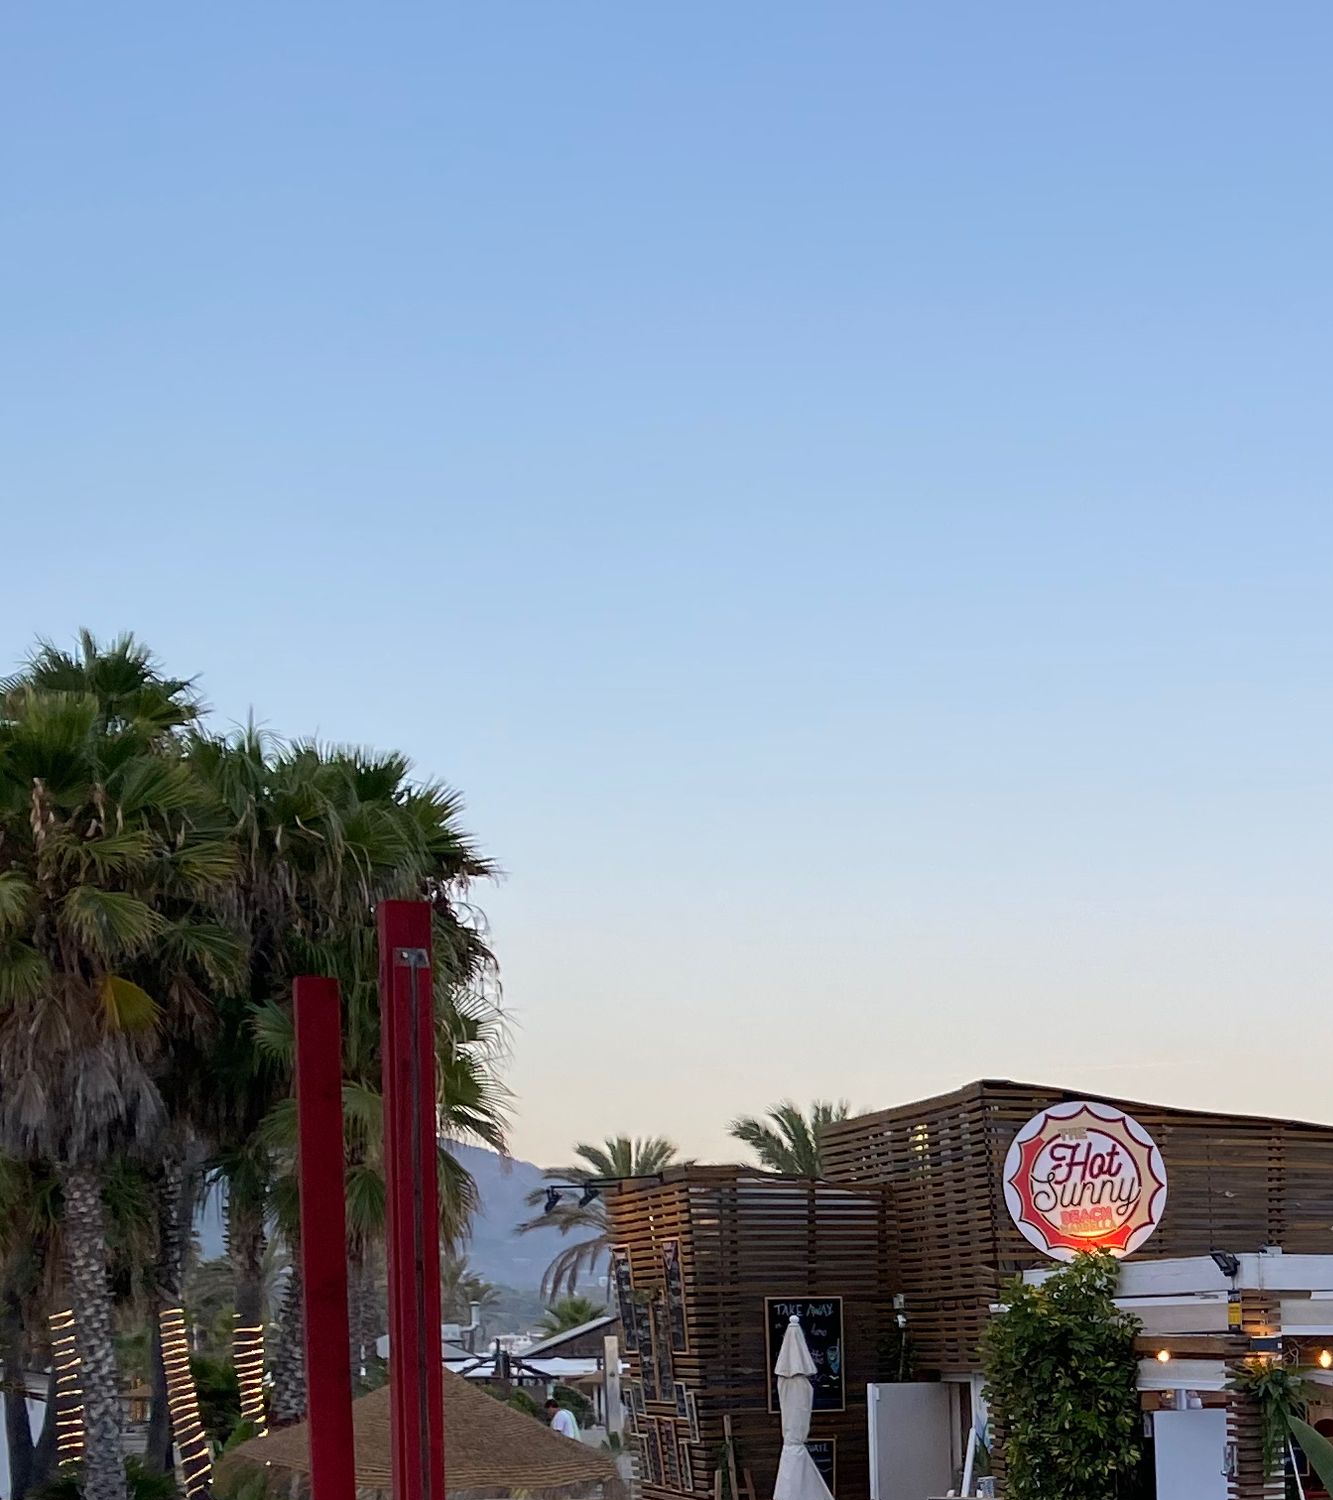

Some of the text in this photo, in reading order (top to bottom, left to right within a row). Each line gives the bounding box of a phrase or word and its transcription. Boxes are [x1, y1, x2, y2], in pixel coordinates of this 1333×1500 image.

[1050, 1142, 1122, 1184] Hot
[1030, 1172, 1141, 1215] Sunny
[774, 1303, 834, 1316] TAKE AWAY
